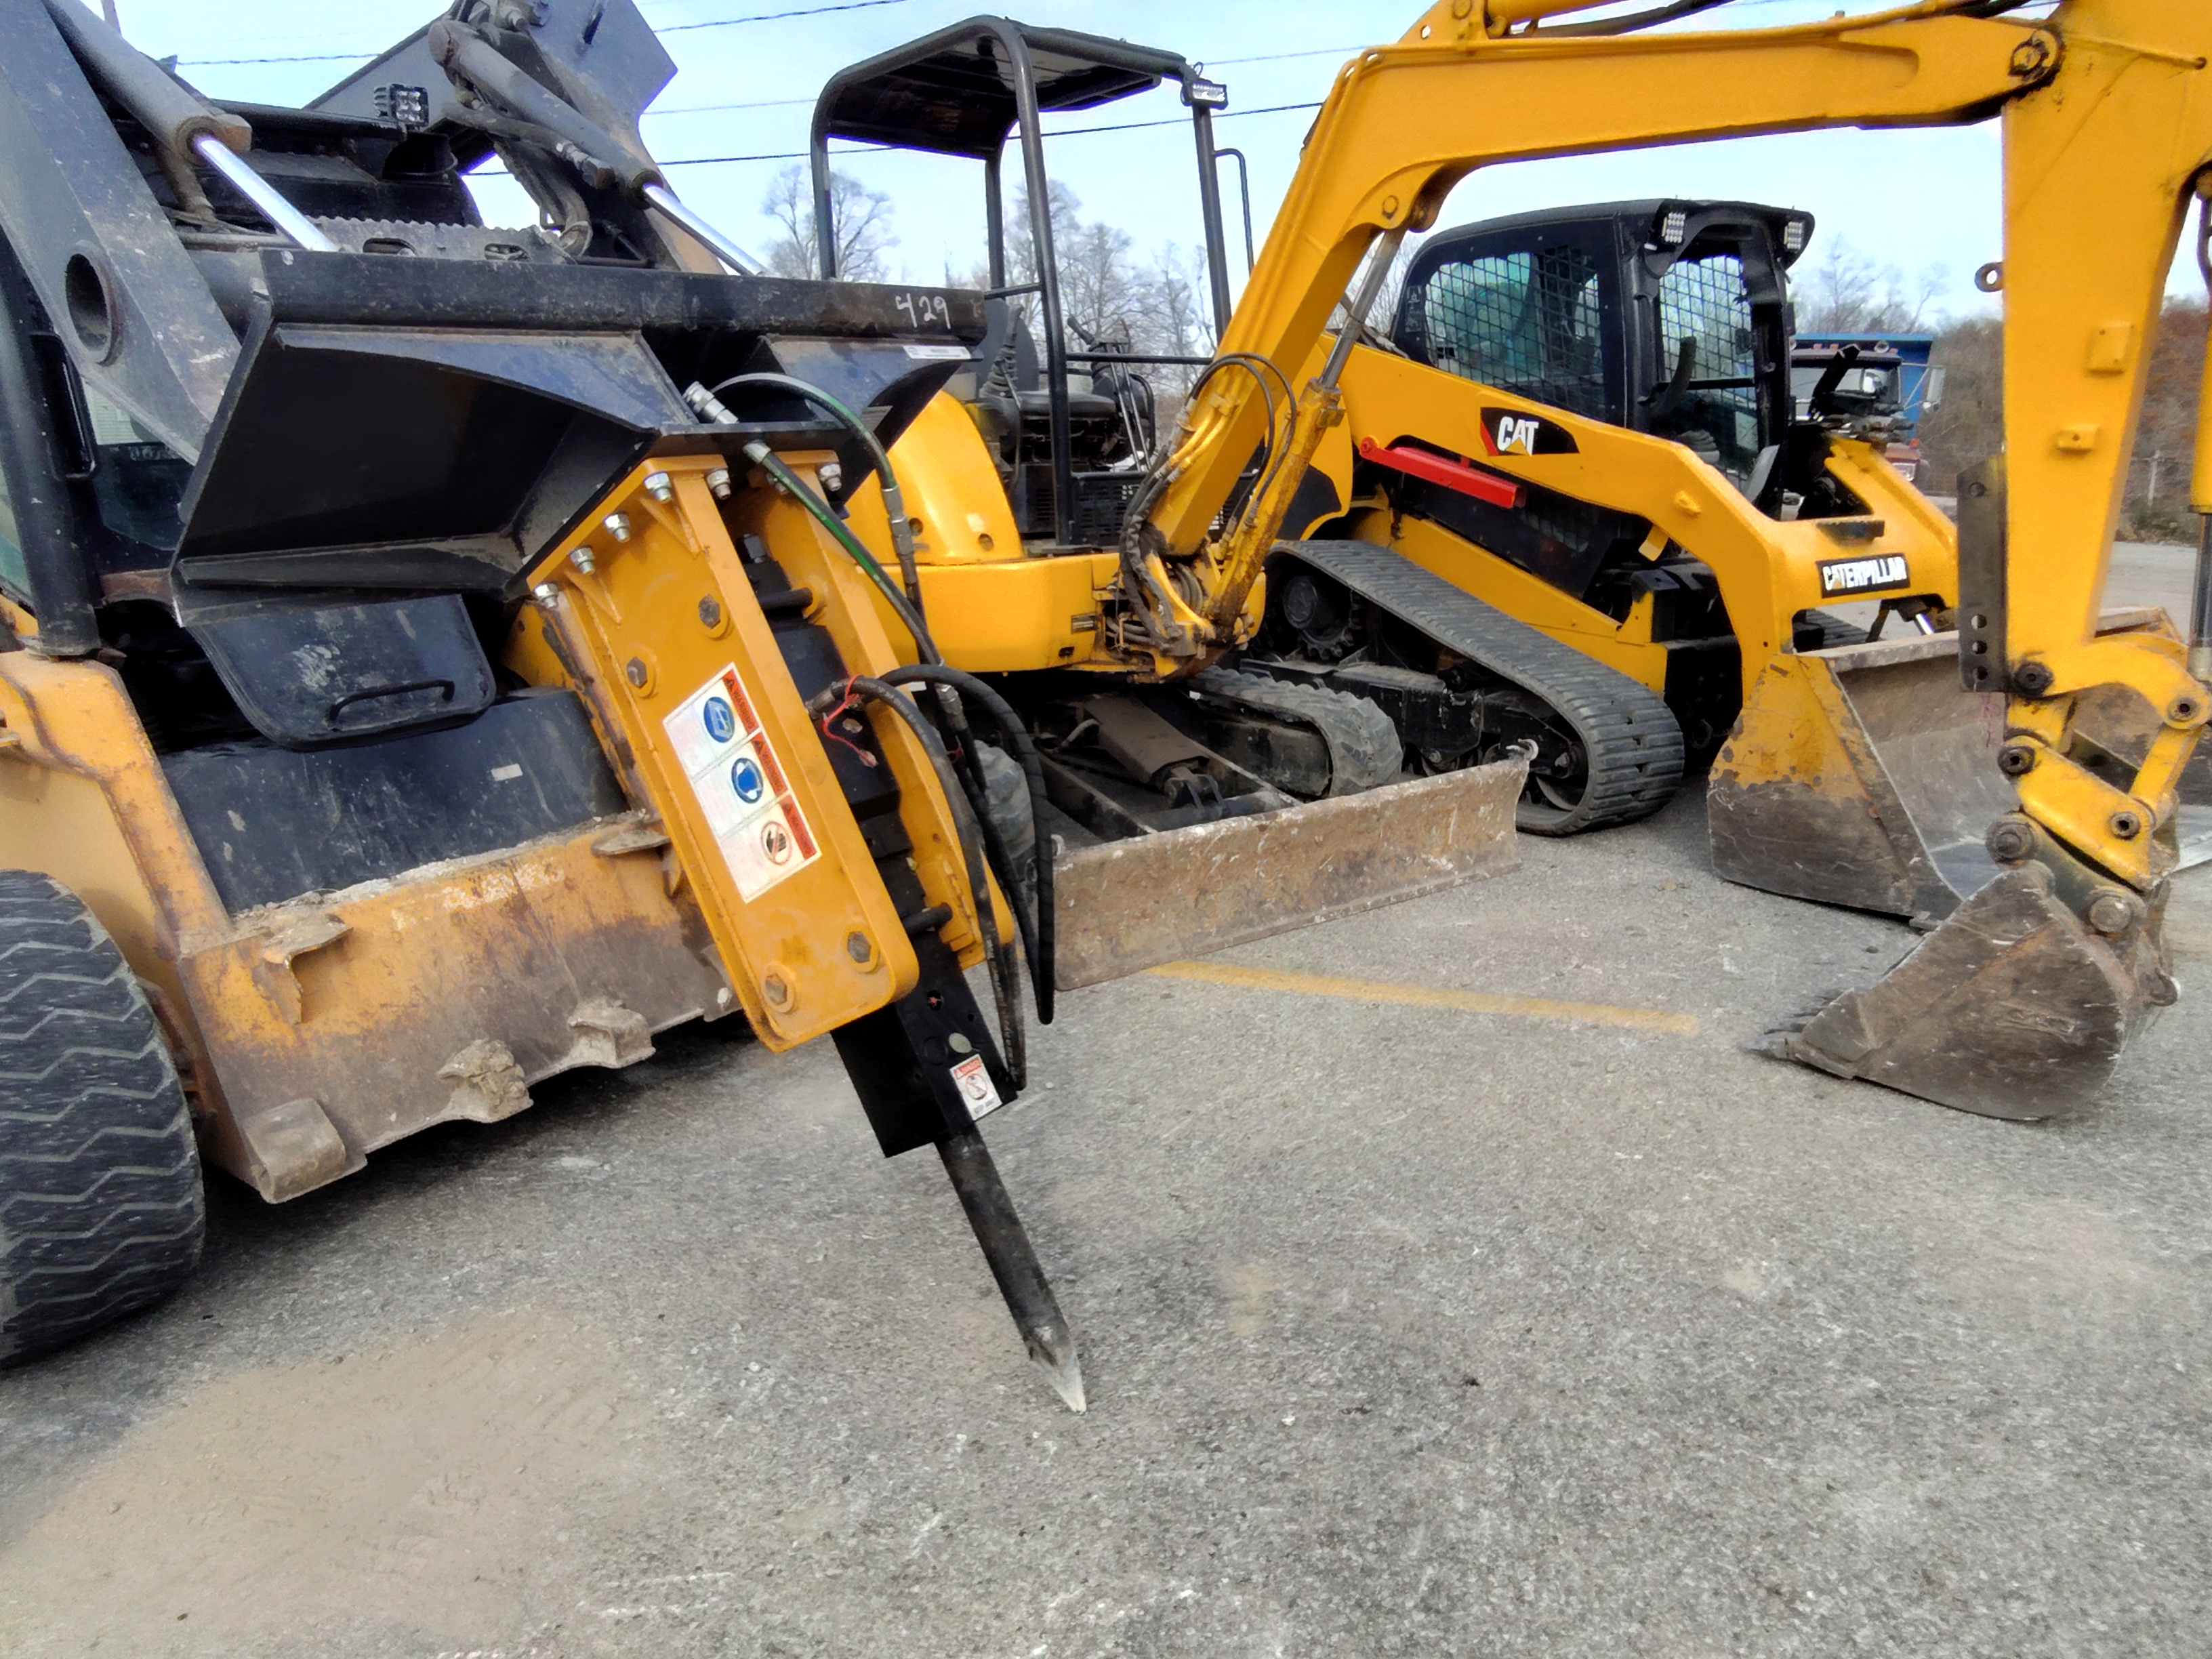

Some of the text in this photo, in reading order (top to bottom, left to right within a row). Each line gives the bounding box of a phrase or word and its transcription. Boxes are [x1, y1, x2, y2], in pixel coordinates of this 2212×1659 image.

[895, 293, 951, 329] 429
[1497, 416, 1539, 456] CAT
[1822, 556, 1907, 590] CATERPILLAR
